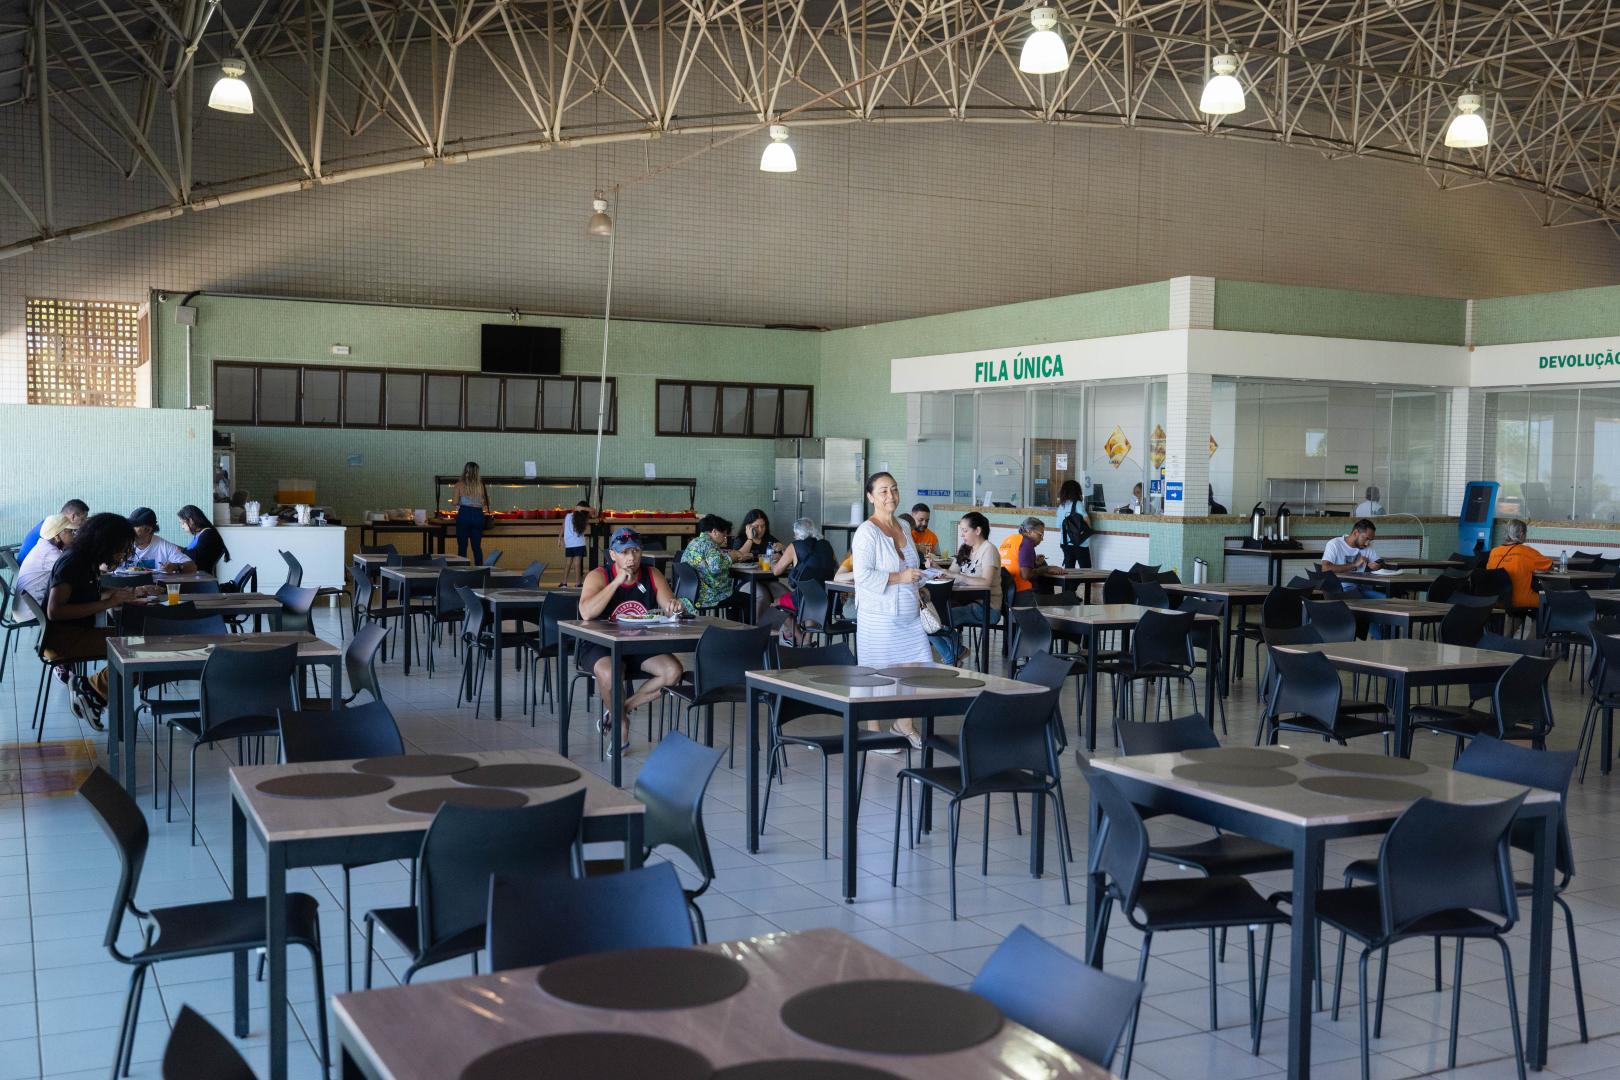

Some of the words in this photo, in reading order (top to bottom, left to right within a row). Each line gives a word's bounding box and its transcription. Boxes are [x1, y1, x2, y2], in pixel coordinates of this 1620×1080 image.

[975, 360, 1009, 383] FILA
[1013, 352, 1064, 380] ÚNICA
[1085, 476, 1092, 488] 3
